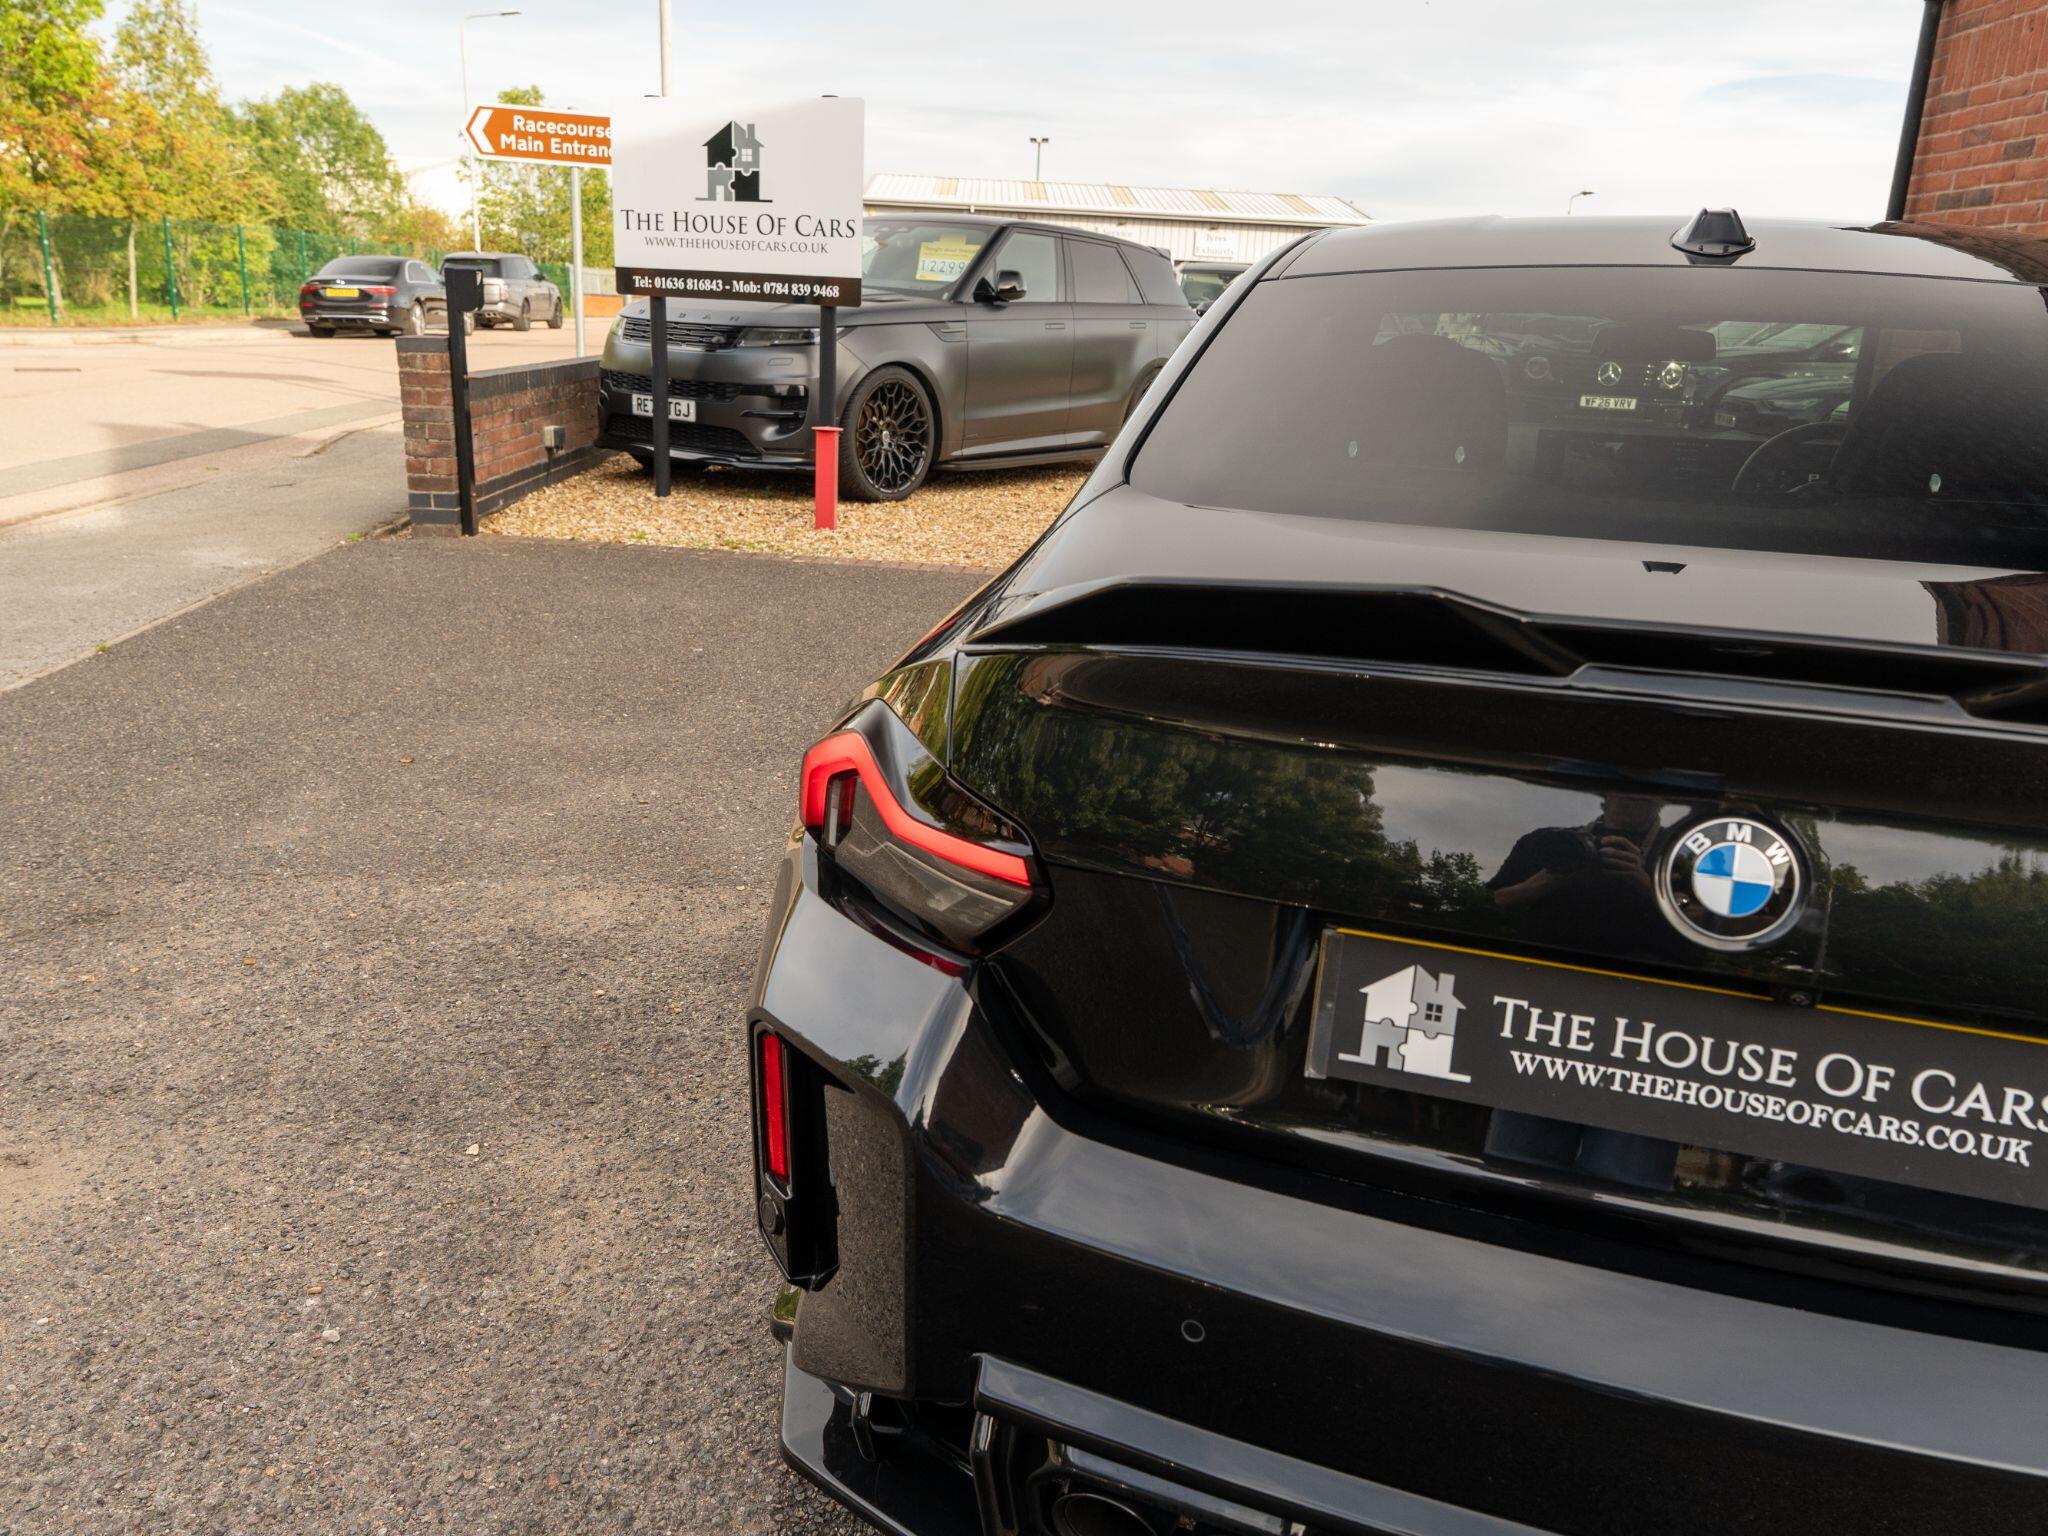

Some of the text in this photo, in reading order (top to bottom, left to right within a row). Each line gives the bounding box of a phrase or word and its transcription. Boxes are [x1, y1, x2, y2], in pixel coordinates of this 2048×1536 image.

[513, 115, 612, 139] Racecourse
[500, 133, 612, 158] Main Entran
[620, 209, 856, 239] THE HOUSE OF CARS
[644, 236, 829, 254] WWW.THEHOUSEOFCARS.CO.UK
[632, 275, 652, 288] Tel:
[654, 276, 684, 290] 01636
[686, 278, 723, 292] 816843
[732, 280, 761, 294] Mob:
[763, 282, 789, 295] 0784
[791, 283, 811, 296] 839
[813, 284, 840, 298] 9468
[1613, 398, 1633, 409] VRV
[1685, 822, 1790, 866] BMW
[1493, 995, 1596, 1053] THE
[1610, 1016, 1798, 1088] HOUSE
[1815, 1053, 1896, 1103] OF
[1510, 1050, 2033, 1168] WWW.THEHOUSEOFCARS.CO.UK
